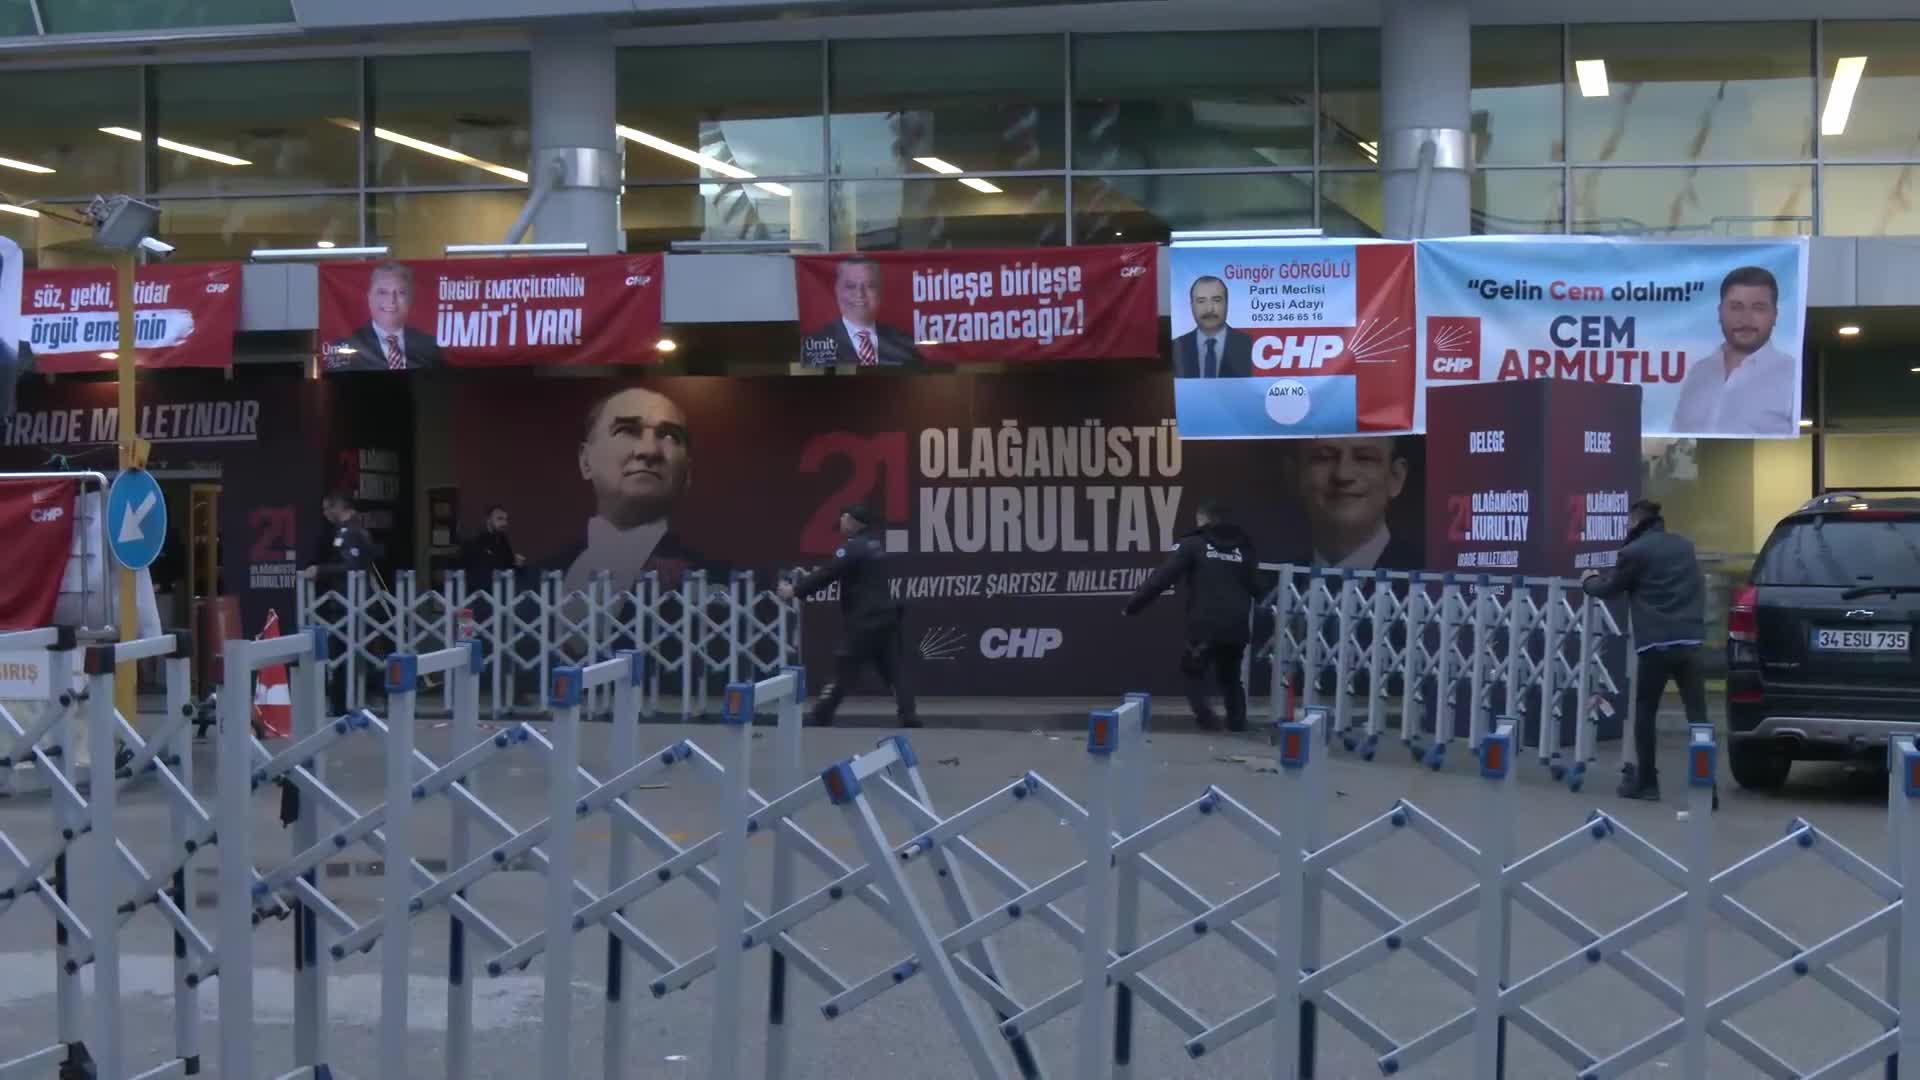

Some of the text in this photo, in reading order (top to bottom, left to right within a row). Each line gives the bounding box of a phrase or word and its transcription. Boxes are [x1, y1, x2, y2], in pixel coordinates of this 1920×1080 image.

[625, 275, 650, 287] CHP
[913, 261, 1081, 305] birleşe birleşe
[1121, 265, 1146, 278] CHP
[1224, 259, 1350, 283] Güngör GÖRGÜLÜ
[33, 282, 170, 311] söz, yetki, tidar
[206, 283, 229, 293] CHP
[439, 272, 584, 302] ÖRGÜT EMEKÇİLERİNİN
[1250, 284, 1325, 295] Parti Meclisi
[1550, 281, 1605, 300] Cem
[1251, 299, 1324, 312] Üyesi Adayı
[1277, 313, 1294, 321] 346
[1297, 313, 1309, 321] 65
[1312, 313, 1323, 321] 16
[31, 314, 167, 348] örgüt emeinin
[525, 307, 582, 345] VAR!
[913, 297, 1084, 345] kazanacağız!
[1549, 315, 1635, 348] CEM
[1251, 336, 1344, 370] CHP
[1432, 357, 1472, 373] CHP
[1497, 349, 1686, 383] ARMUTLU
[1268, 387, 1306, 396] ADAY NO:
[90, 400, 259, 442] MLETİNDİR
[920, 420, 1182, 478] OLAĞANÜSTÜ
[1470, 431, 1504, 453] DELEGE
[1584, 431, 1611, 453] DELEGE
[799, 431, 909, 553] 21.
[31, 507, 63, 522] CHP
[919, 486, 1183, 552] KURULTAY
[1472, 515, 1529, 541] KURULTAY
[906, 575, 981, 599] KAYITSIZ
[986, 572, 1057, 598] ŞARTSIZ
[979, 628, 1063, 659] CHP
[1820, 632, 1906, 648] 34 ESU 735
